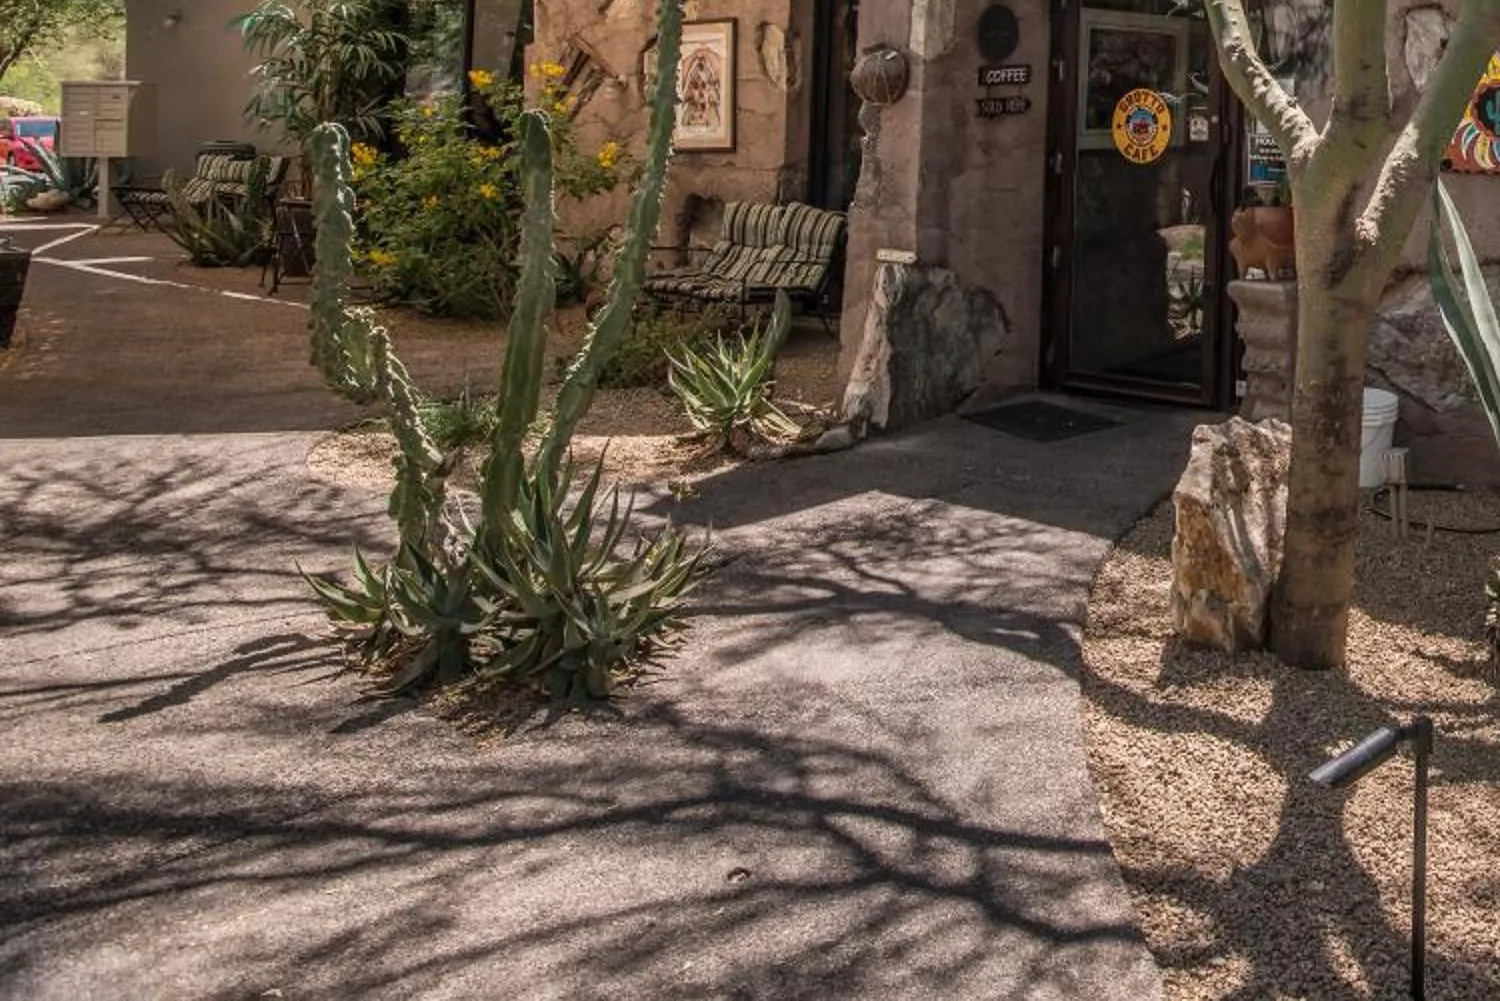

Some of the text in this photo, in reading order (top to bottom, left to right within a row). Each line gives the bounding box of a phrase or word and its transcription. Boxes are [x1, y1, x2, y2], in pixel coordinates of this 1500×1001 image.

[986, 69, 1027, 83] COFFEE
[1119, 91, 1165, 114] GROTTO
[1123, 144, 1158, 160] CAFE
